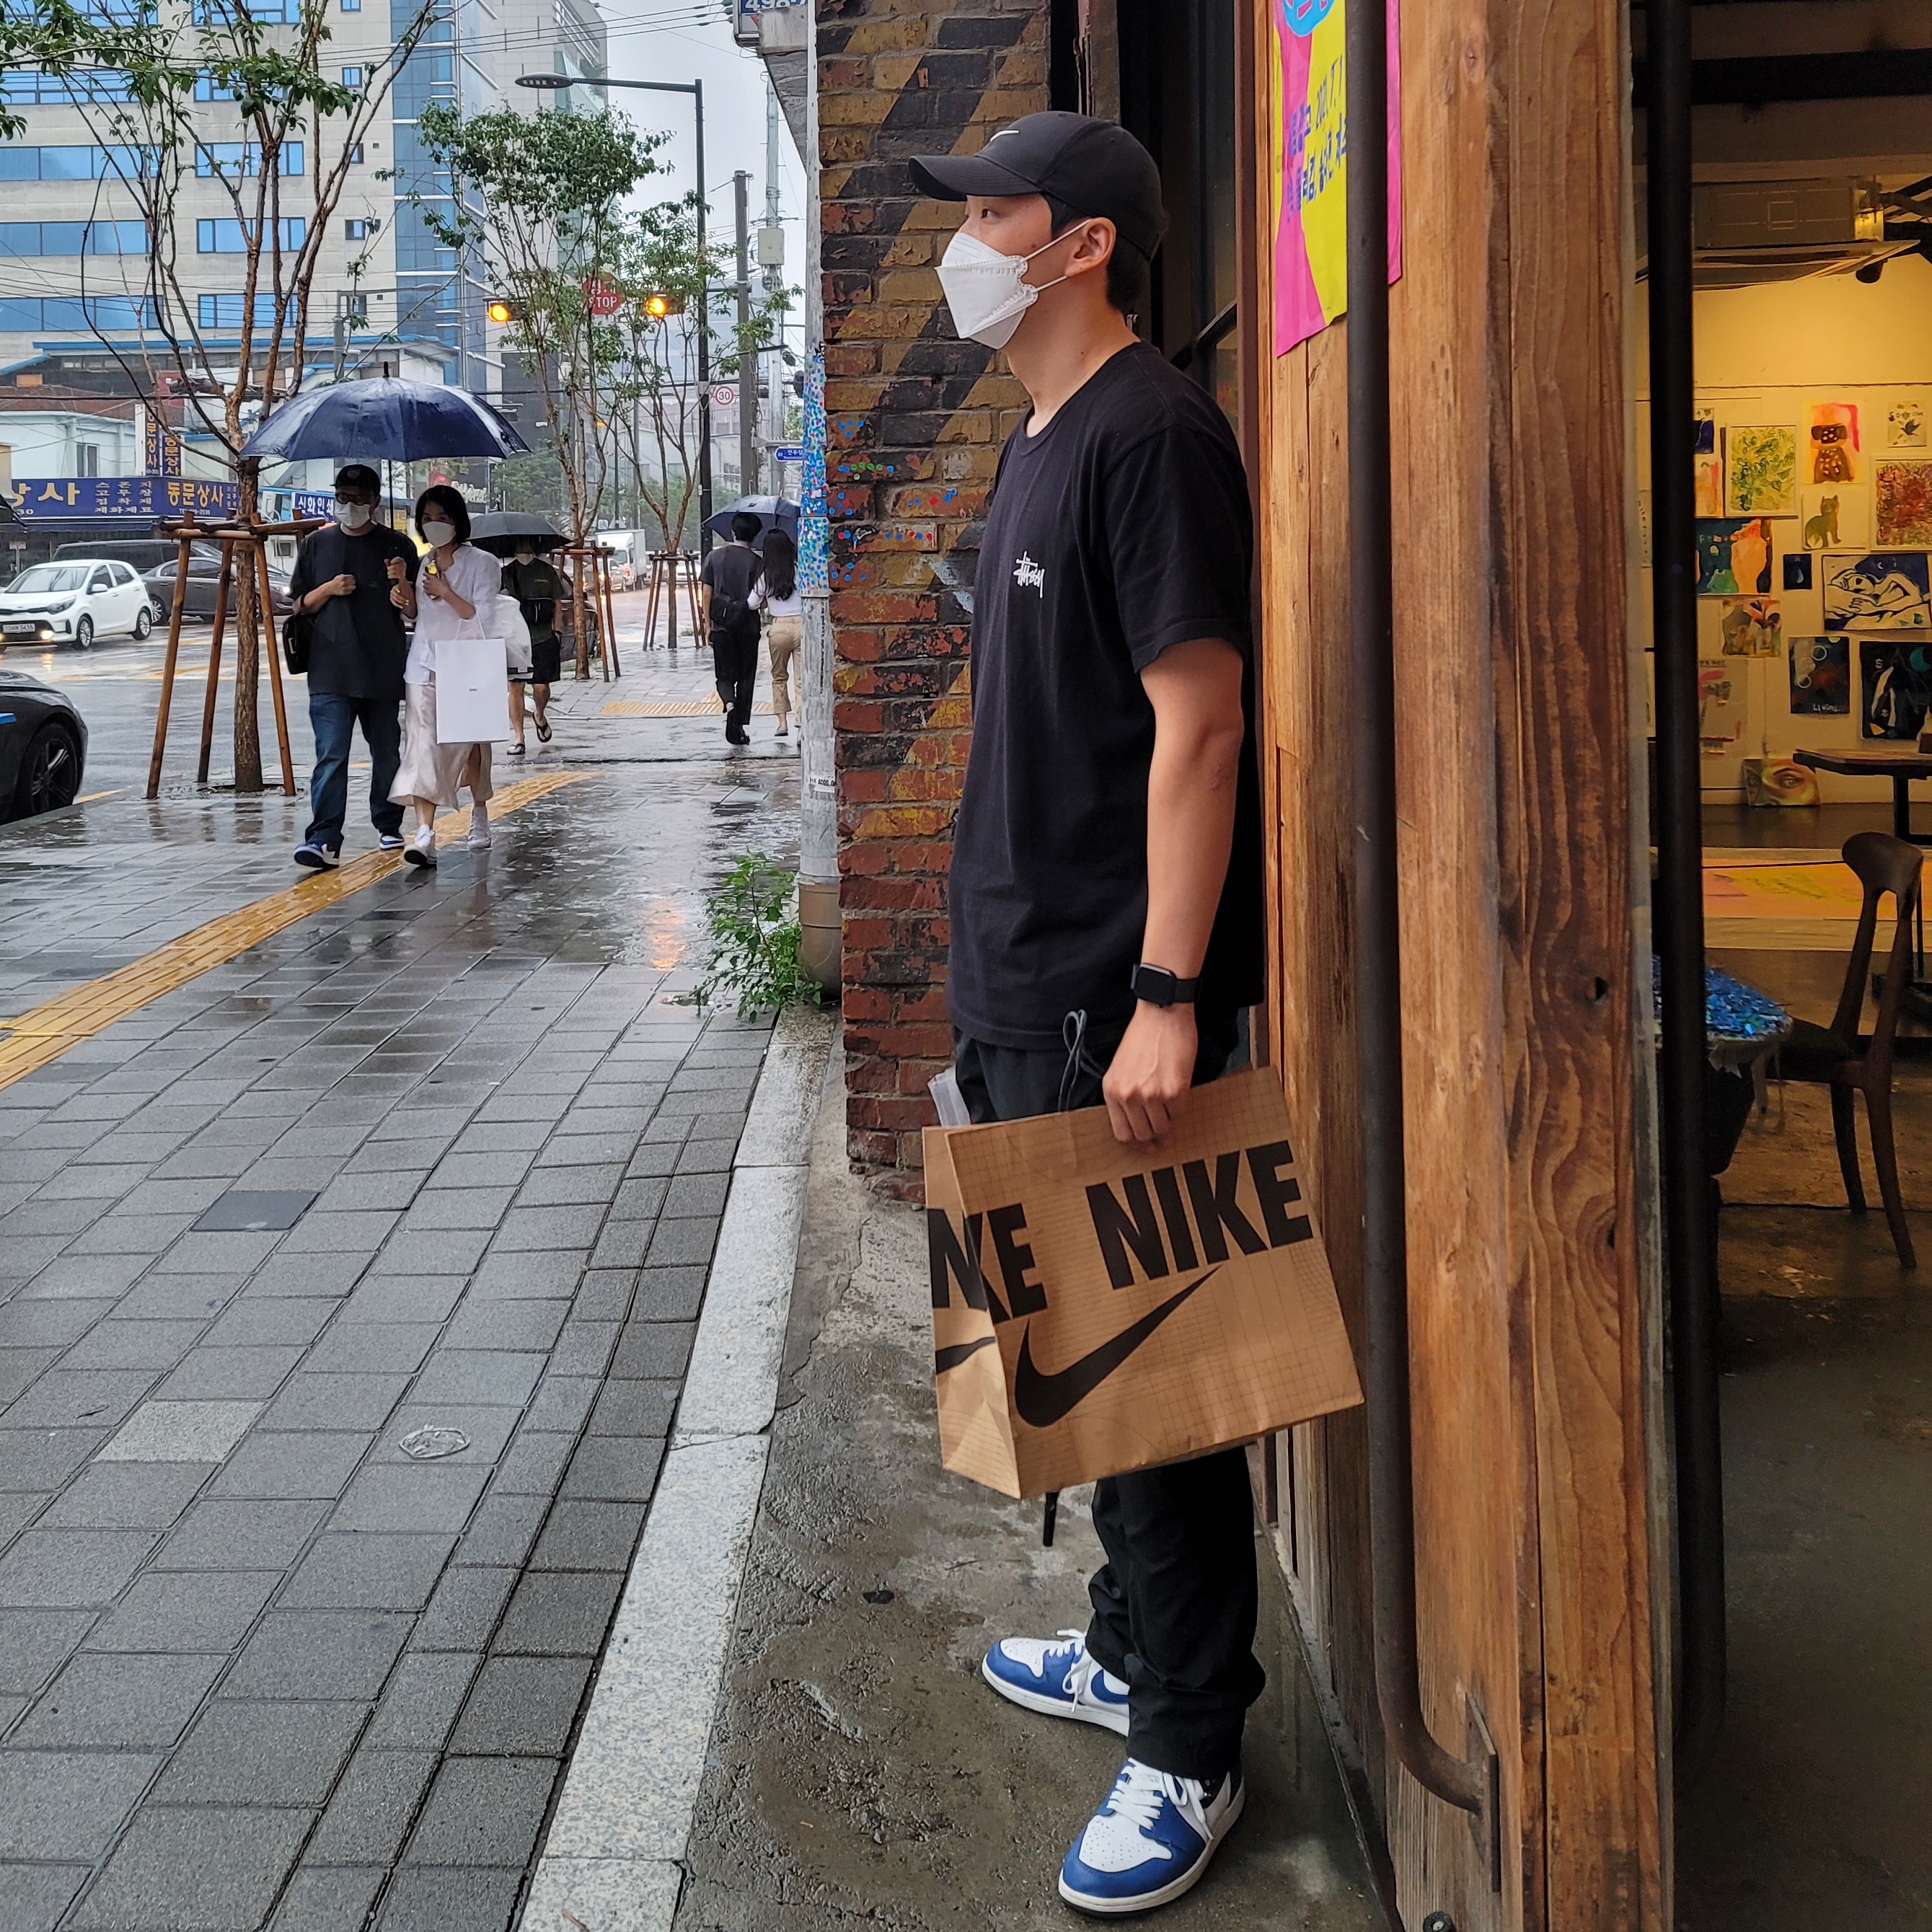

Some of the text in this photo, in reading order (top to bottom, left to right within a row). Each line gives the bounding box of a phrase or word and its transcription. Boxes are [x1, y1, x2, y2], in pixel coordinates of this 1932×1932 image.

[718, 392, 731, 400] 30
[167, 481, 224, 507] 동문상사
[299, 496, 334, 516] 신화인쇄
[1085, 1139, 1314, 1290] NIKE
